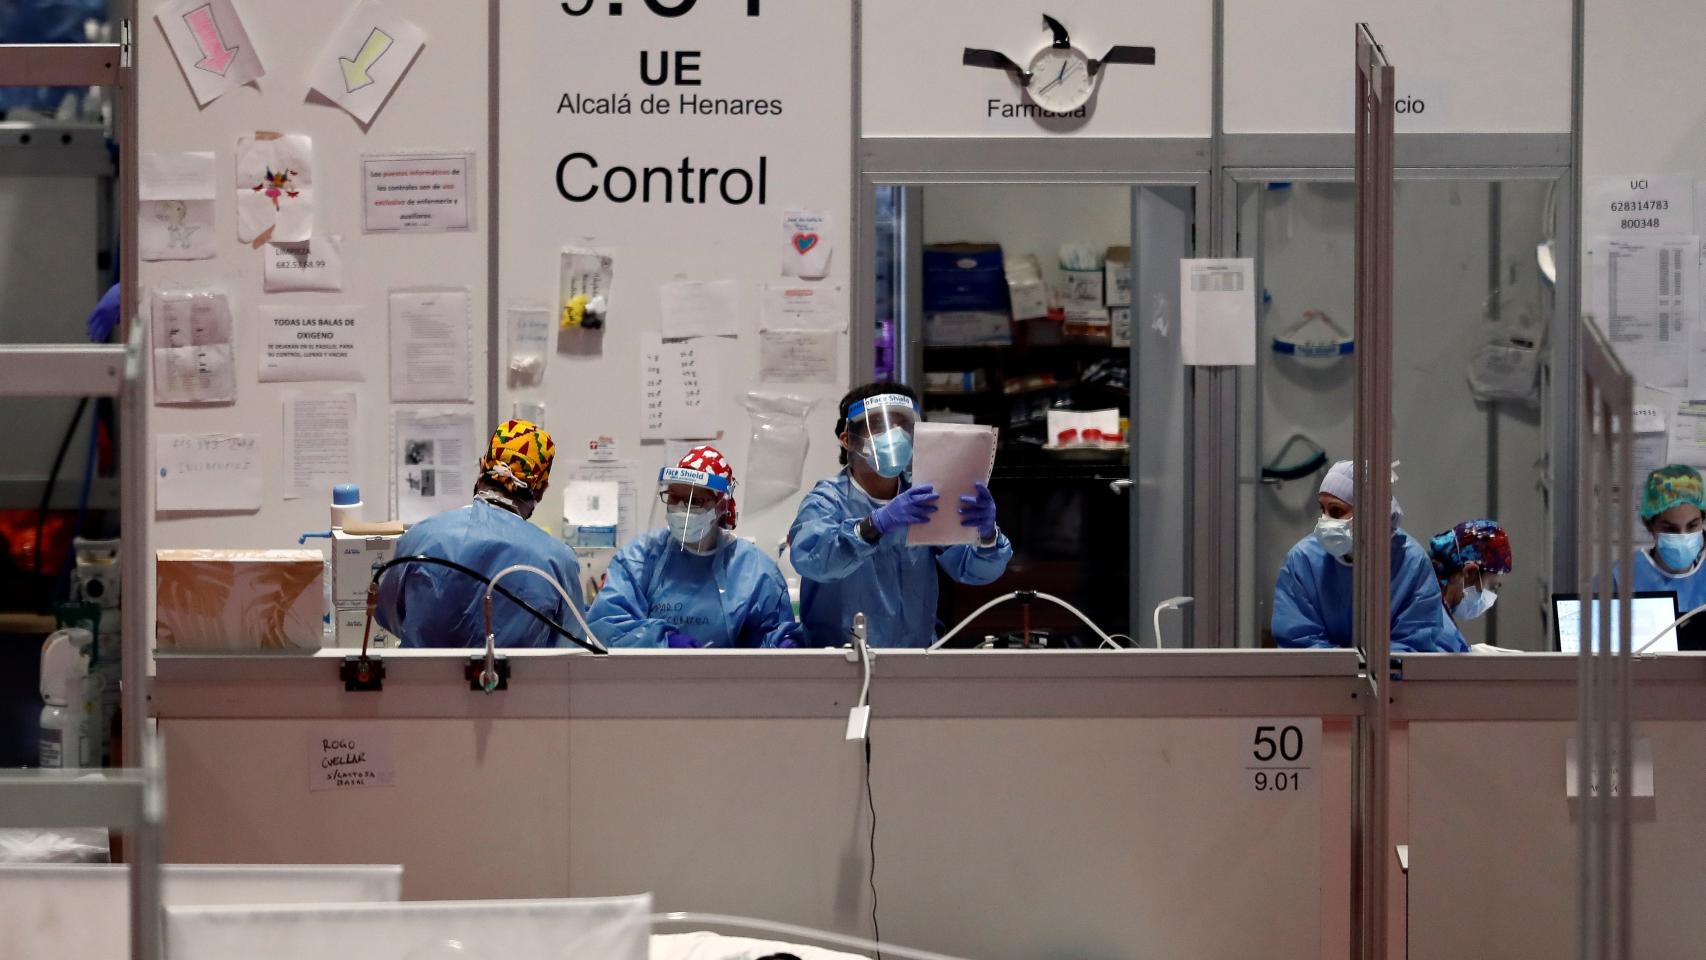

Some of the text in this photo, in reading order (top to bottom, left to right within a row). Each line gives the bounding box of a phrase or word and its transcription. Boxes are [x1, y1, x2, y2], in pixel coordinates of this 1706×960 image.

[640, 50, 702, 86] UE
[556, 93, 783, 116] Alcalá de Henares
[555, 152, 767, 205] Control
[1630, 179, 1649, 190] UCI
[1610, 200, 1669, 212] 628314783
[1620, 218, 1660, 229] 800348
[888, 394, 910, 404] Shield
[680, 469, 704, 480] Shield
[1253, 725, 1303, 762] 50
[1254, 772, 1298, 791] 9.01
